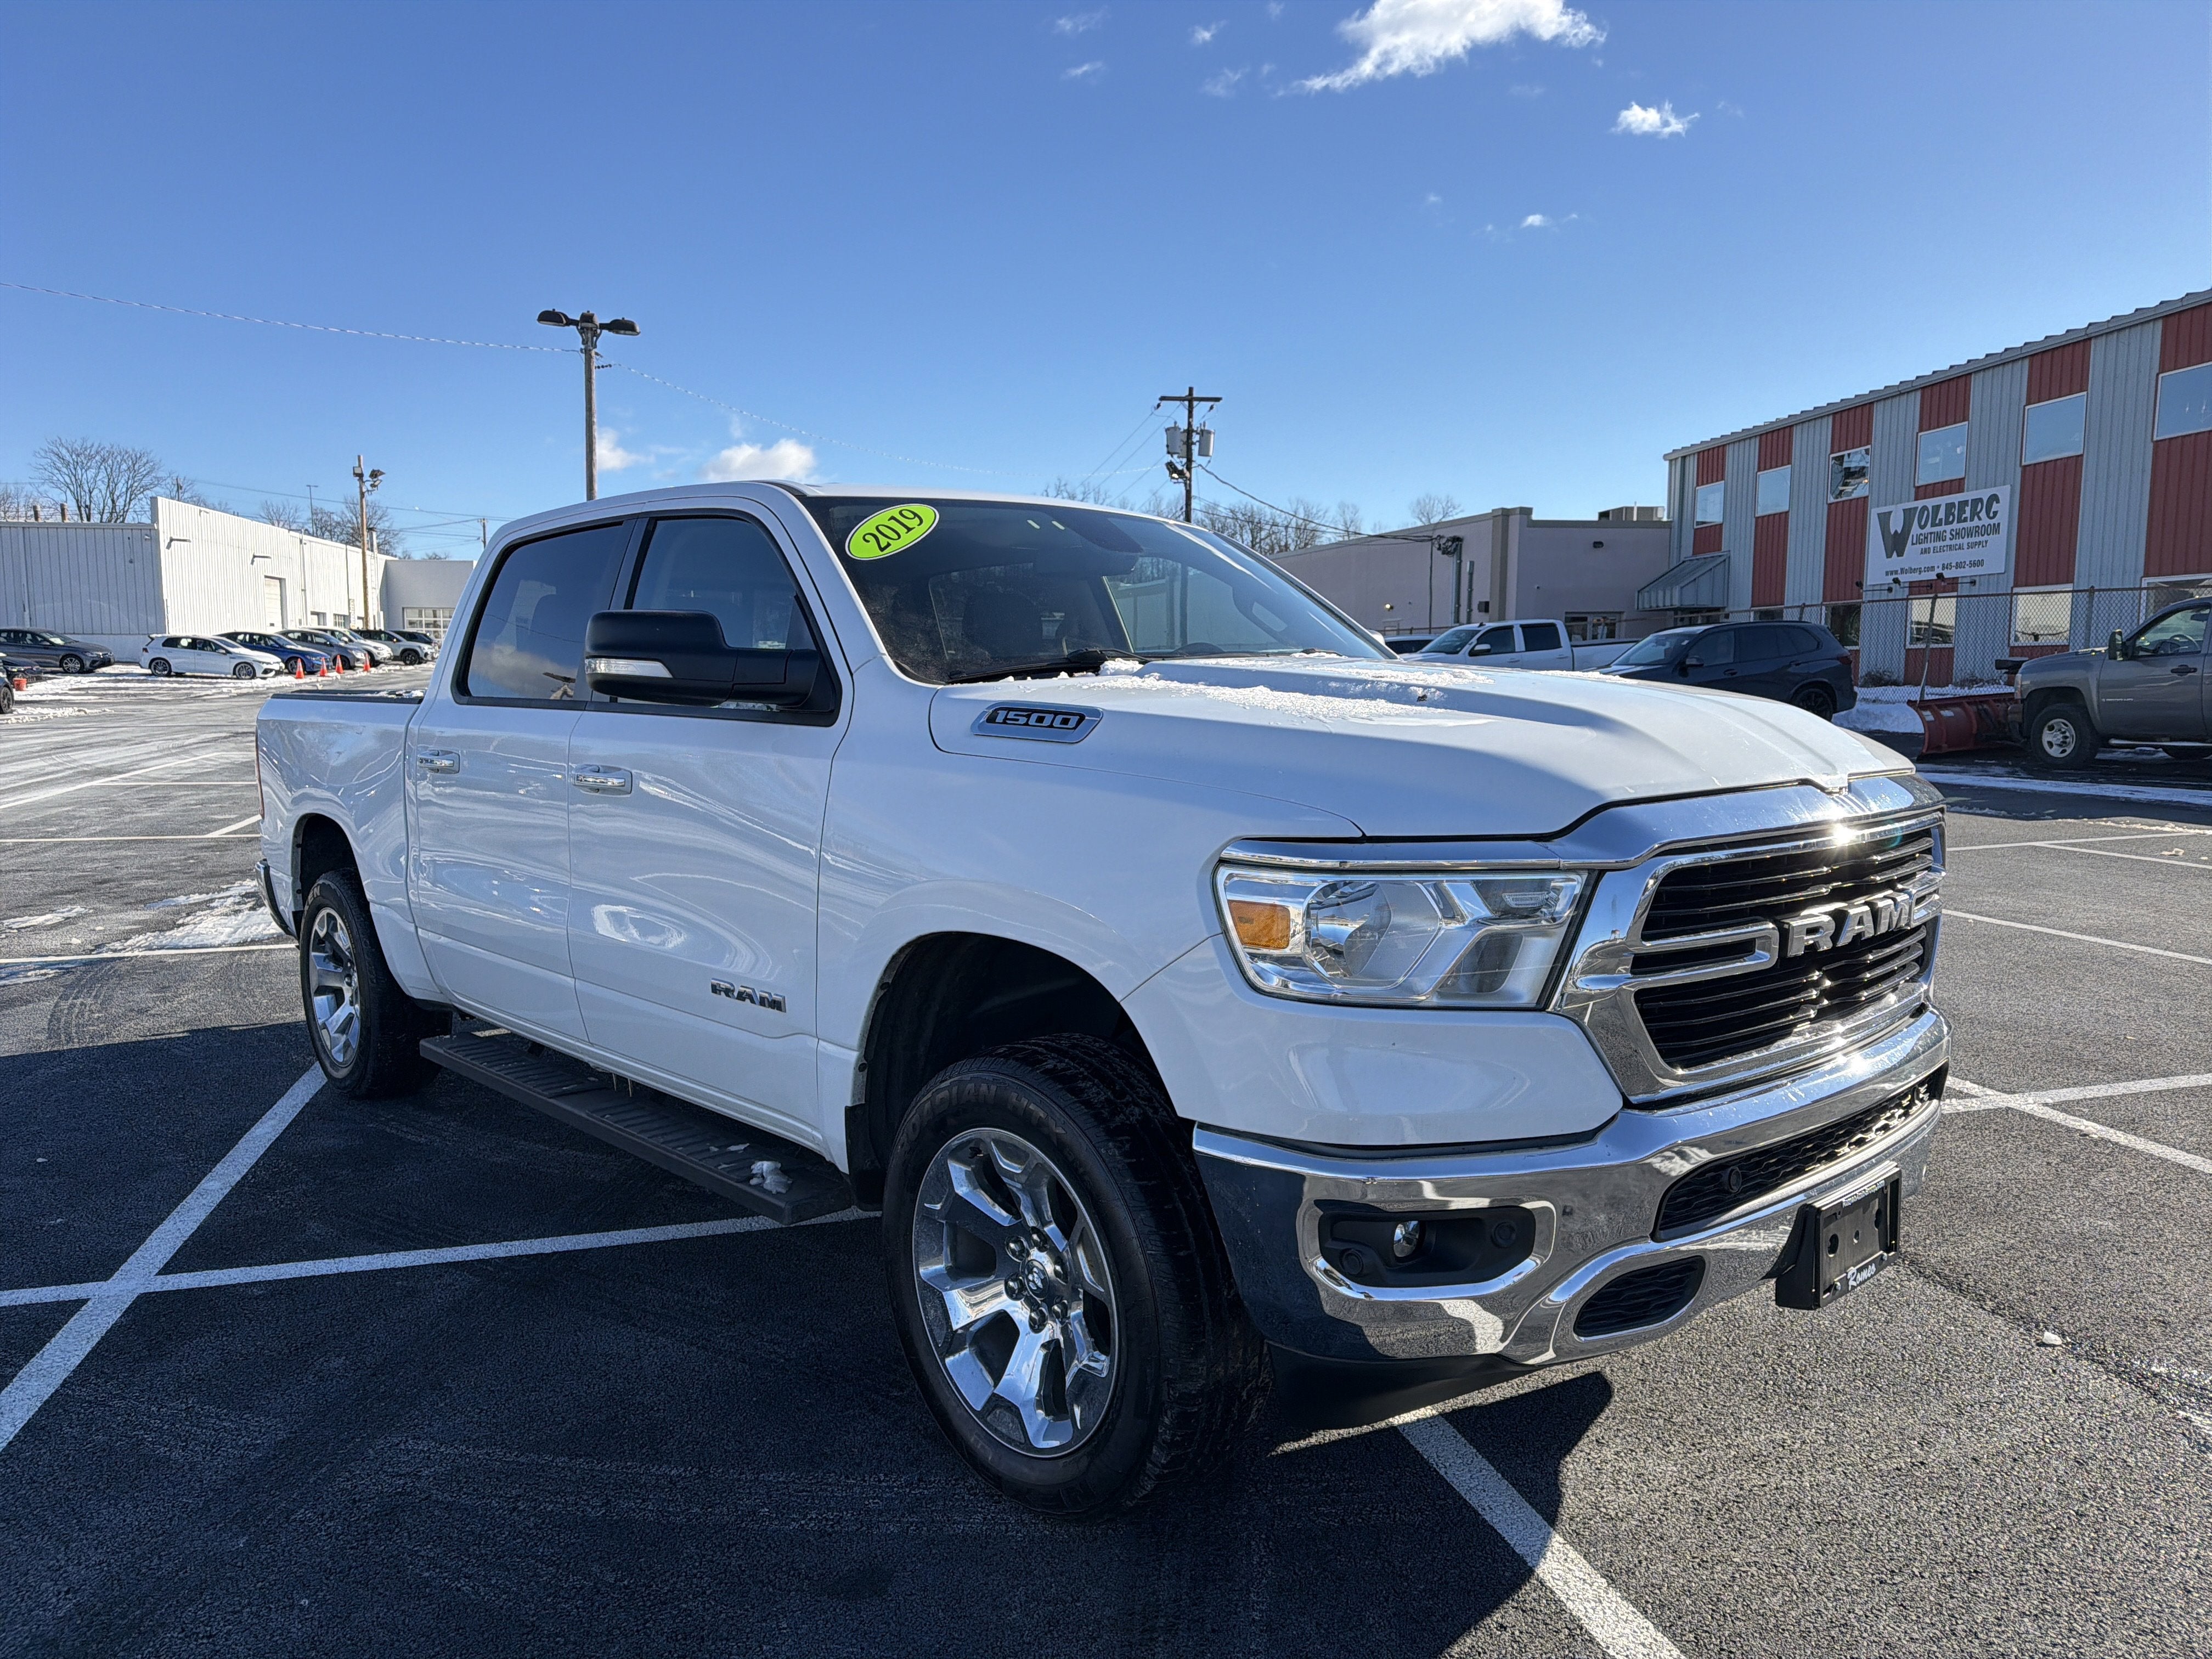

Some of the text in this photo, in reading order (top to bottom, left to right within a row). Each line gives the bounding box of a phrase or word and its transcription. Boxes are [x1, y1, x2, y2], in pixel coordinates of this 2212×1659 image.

[862, 509, 923, 552] 2019
[1877, 493, 2000, 558] WOLBERG
[1911, 522, 2001, 545] LIGHTING SHOWROOM
[1933, 543, 1965, 554] ELECTRICAL
[1967, 540, 1988, 550] SUPPLY
[1885, 559, 1984, 576] www.Wolberg.com 845-802-5600
[995, 710, 1080, 728] 1500
[1784, 891, 1912, 957] RAM
[711, 978, 786, 1013] RAM
